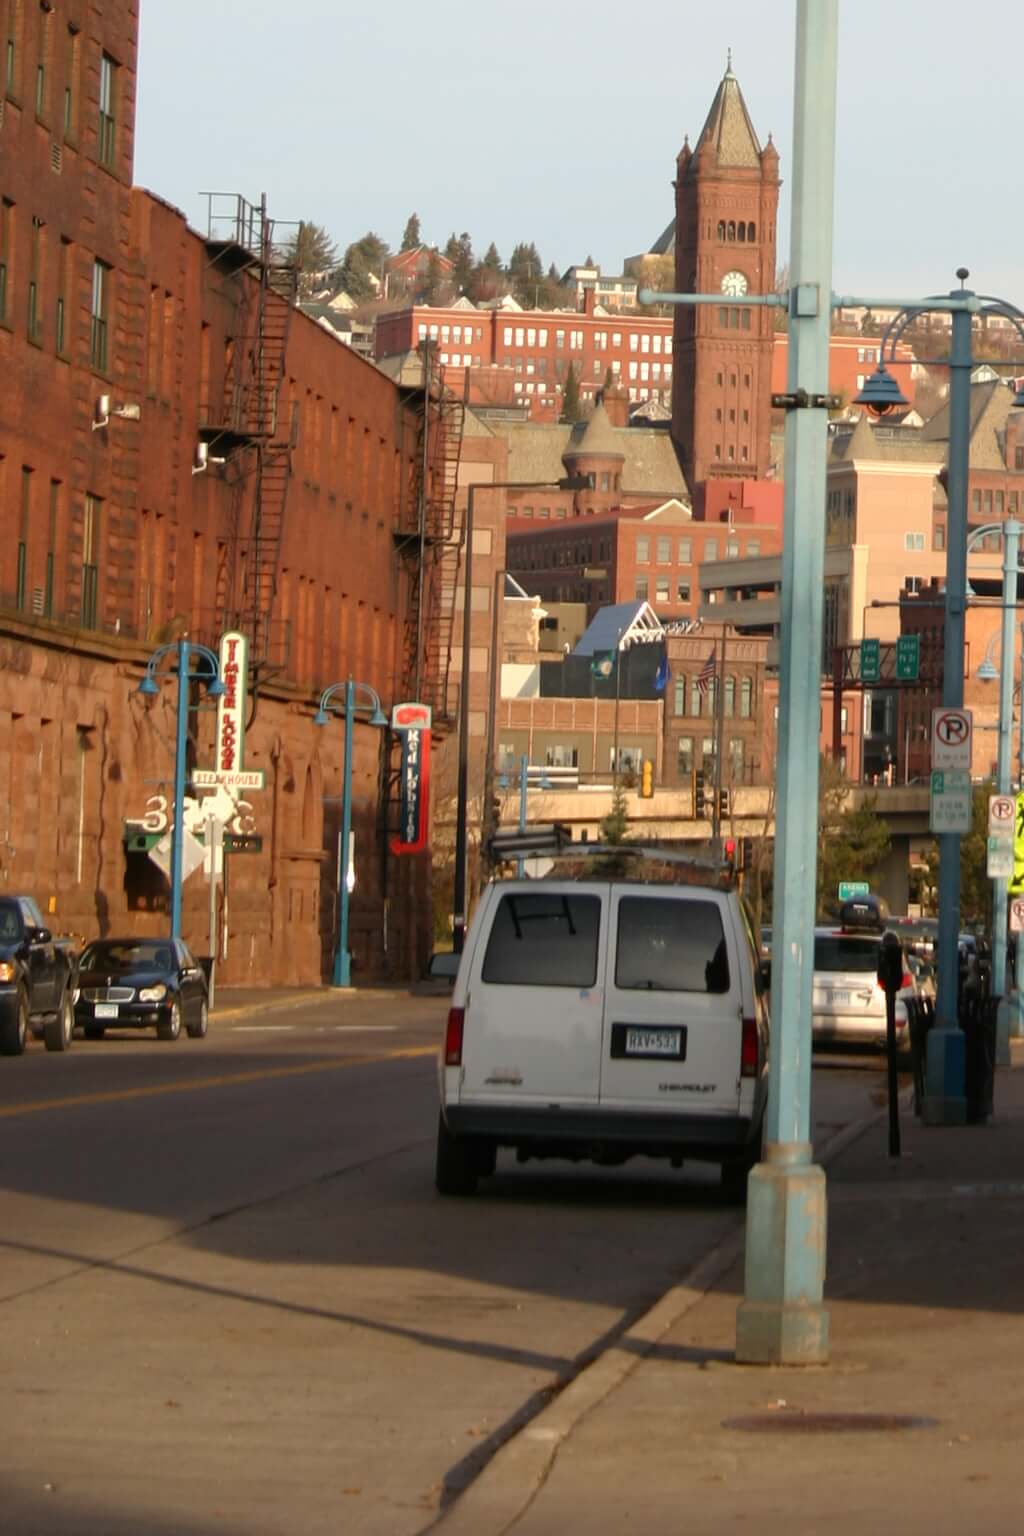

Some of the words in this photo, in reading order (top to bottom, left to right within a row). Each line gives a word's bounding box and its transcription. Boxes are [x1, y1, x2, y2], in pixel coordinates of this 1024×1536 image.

[221, 639, 240, 709] TIMBER
[220, 714, 236, 770] LODGE
[407, 728, 420, 764] Red
[196, 772, 261, 786] STEAKHOUSE
[406, 767, 420, 843] Lobster
